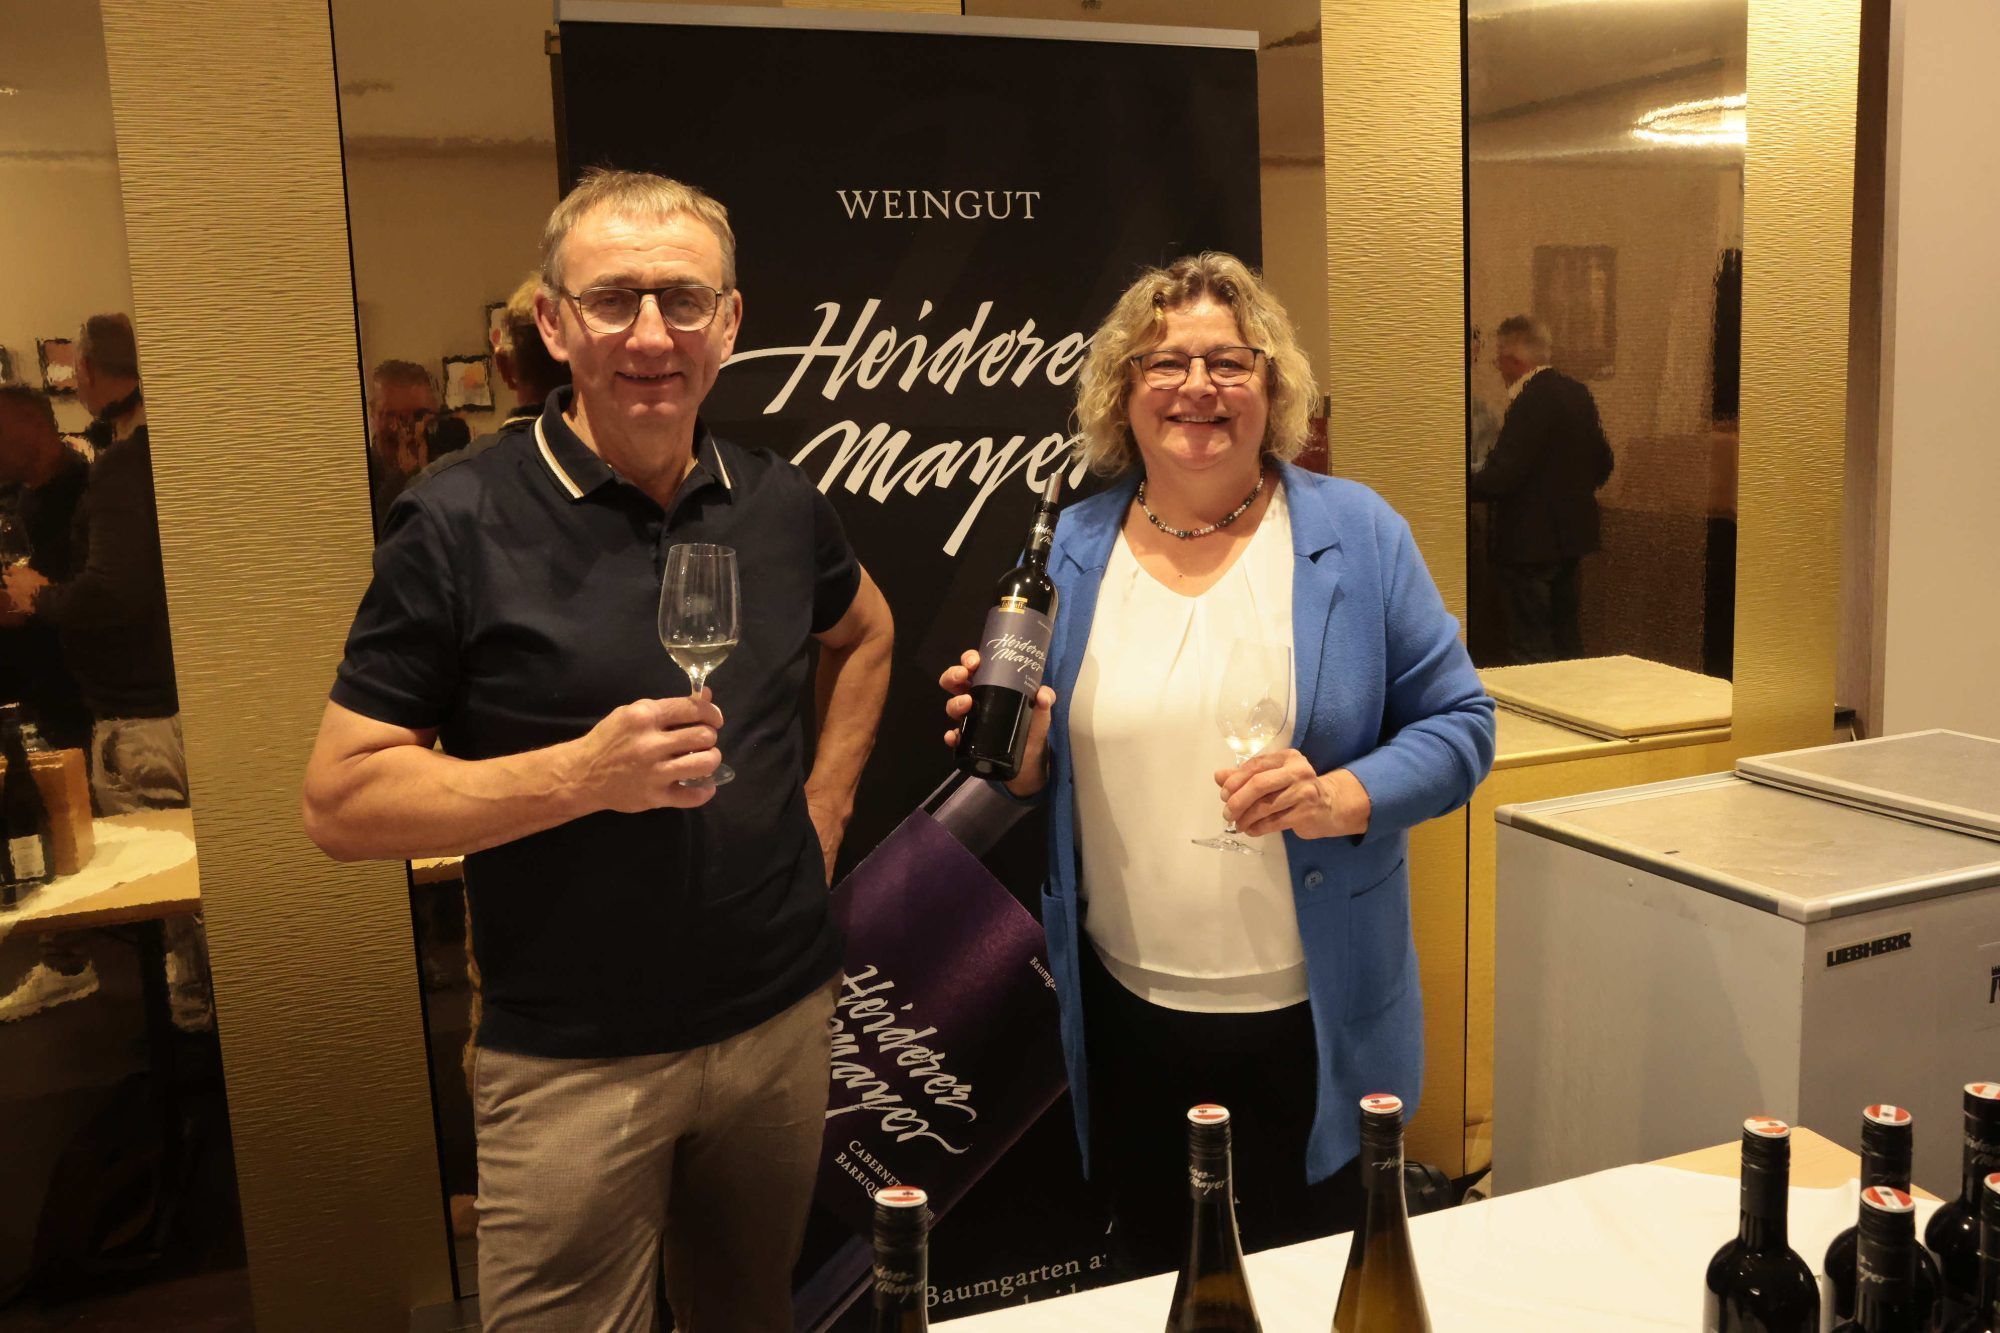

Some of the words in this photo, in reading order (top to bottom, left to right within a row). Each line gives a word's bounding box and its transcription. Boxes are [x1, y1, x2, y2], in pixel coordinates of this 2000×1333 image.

[836, 189, 1041, 220] WEINGUT
[719, 298, 1098, 415] Heidere
[991, 648, 1044, 673] Mayer
[1826, 932, 1912, 968] LIEBHERR
[926, 1259, 1082, 1308] Baumgarten
